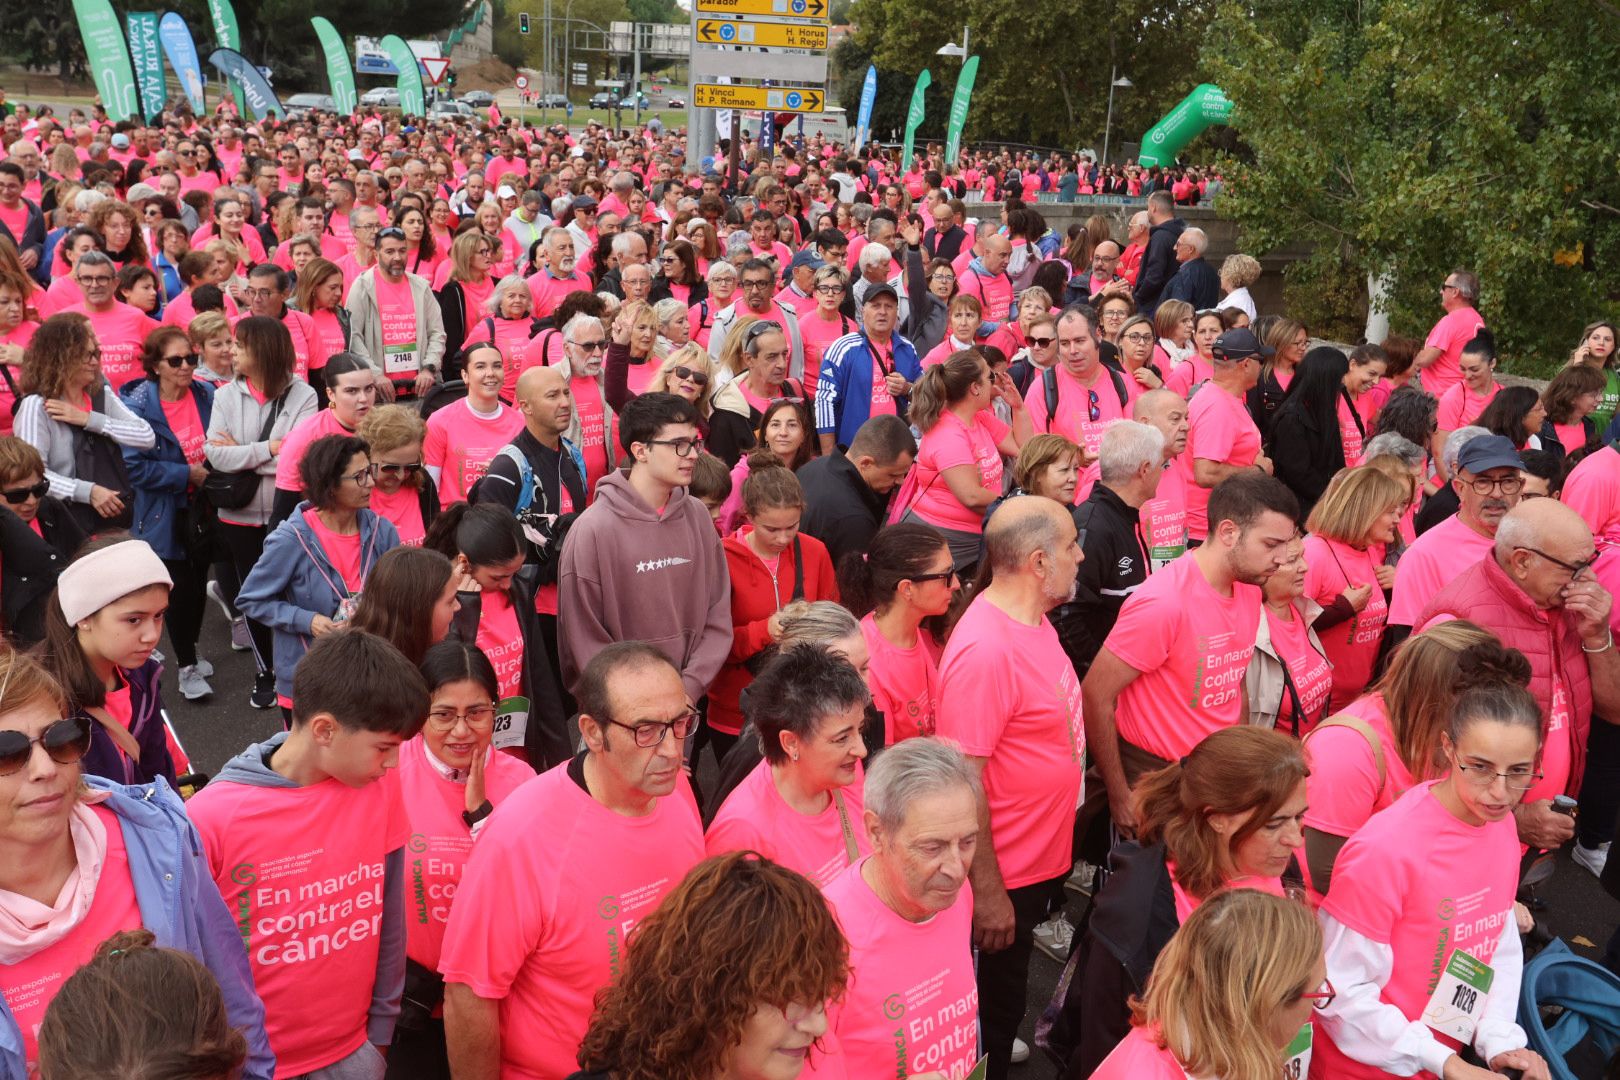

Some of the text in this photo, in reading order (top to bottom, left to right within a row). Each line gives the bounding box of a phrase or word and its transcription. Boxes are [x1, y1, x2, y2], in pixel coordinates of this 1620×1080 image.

[800, 28, 825, 38] Horus
[800, 37, 825, 48] Regio
[710, 88, 735, 97] Vincci
[720, 97, 756, 107] Romano
[1202, 102, 1224, 110] contra
[382, 313, 392, 321] En
[383, 321, 414, 330] contra
[123, 351, 133, 361] el
[393, 352, 412, 363] 2148
[101, 362, 132, 374] ncer
[1152, 515, 1164, 525] En
[1207, 654, 1222, 669] En
[1296, 673, 1309, 689] En
[428, 858, 454, 875] En
[257, 862, 385, 908] En marcha
[412, 859, 429, 925] SALAMANCA
[257, 883, 384, 935] contra el
[256, 911, 384, 966] cáncer
[1453, 923, 1473, 943] En
[21, 972, 62, 991] española
[14, 987, 45, 1002] cáncer
[1451, 984, 1478, 1015] 1028
[910, 1016, 934, 1043] En
[912, 1018, 977, 1073] contra
